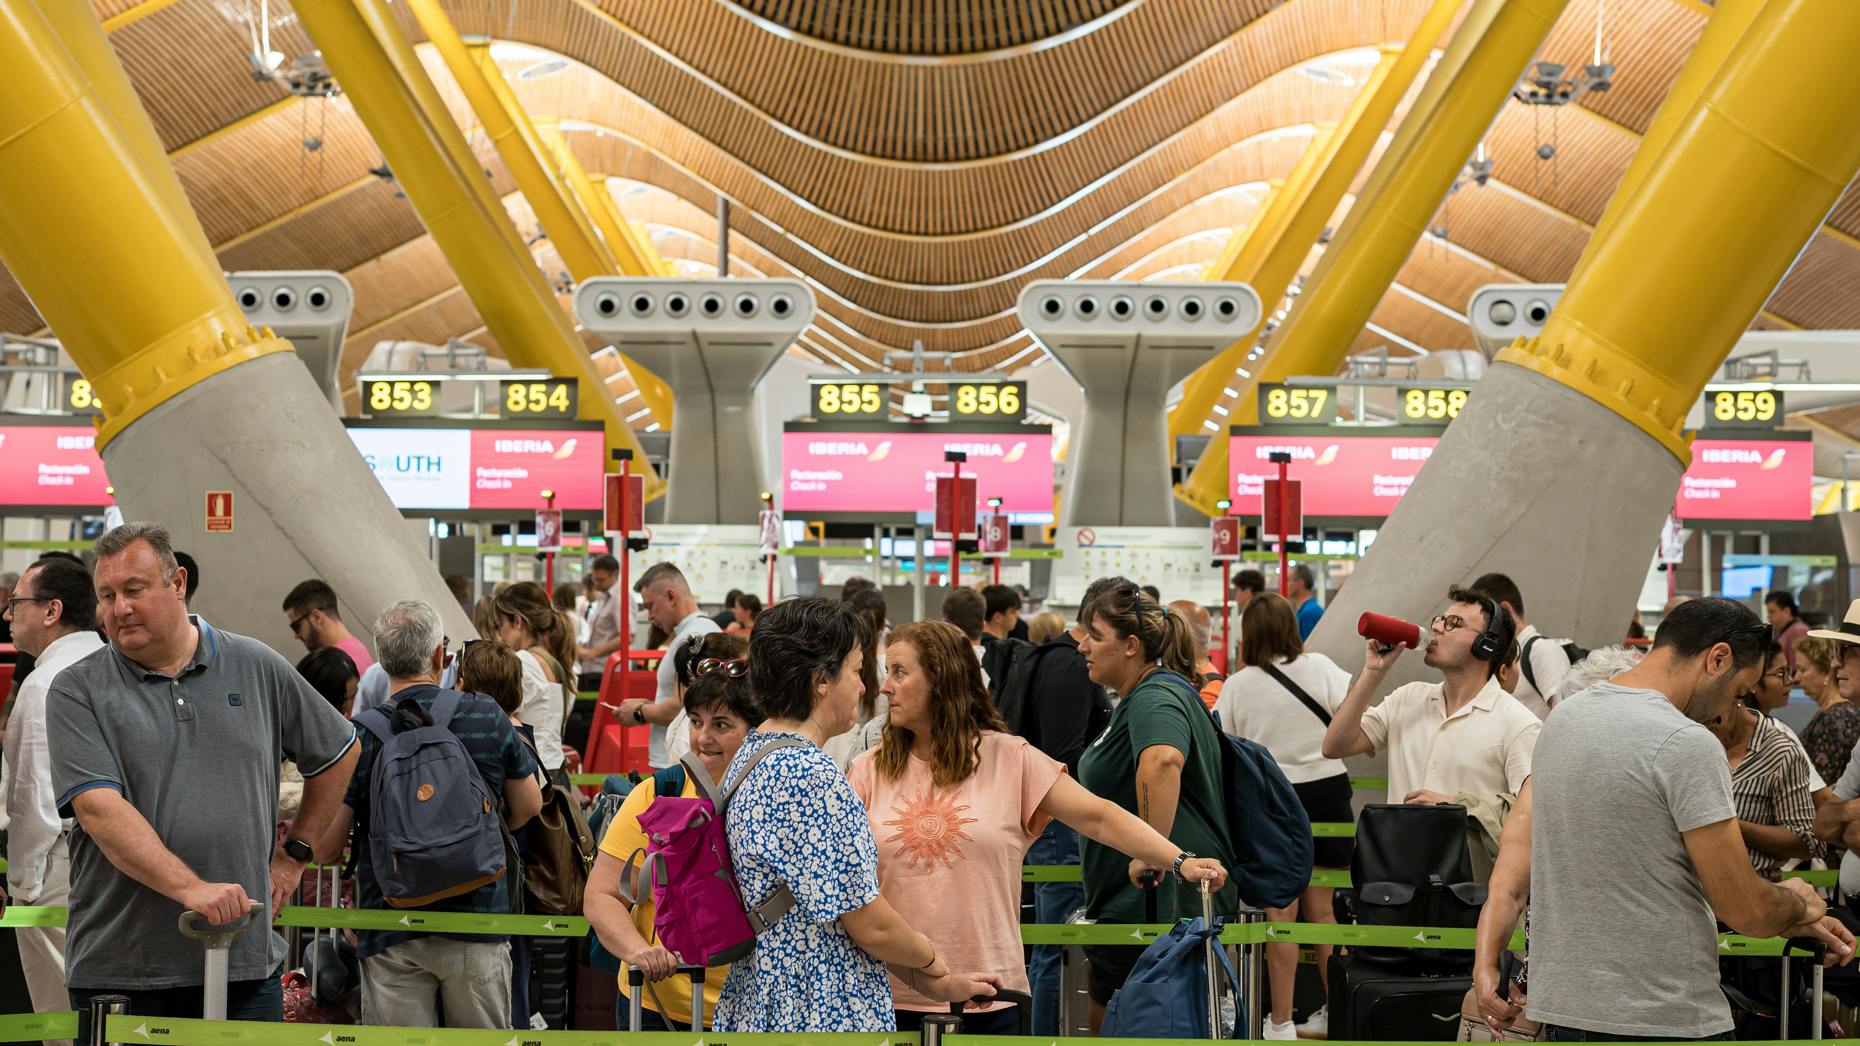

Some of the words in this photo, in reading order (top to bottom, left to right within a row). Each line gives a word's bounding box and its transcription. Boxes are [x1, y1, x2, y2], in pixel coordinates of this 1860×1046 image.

[370, 381, 432, 411] 853
[507, 383, 570, 412] 854
[819, 384, 881, 413] 855
[956, 385, 1020, 414] 856
[1267, 389, 1328, 418] 857
[1405, 390, 1467, 419] 858
[1714, 391, 1776, 421] 859
[495, 440, 554, 453] IBERIA
[808, 442, 868, 455] IBERIA
[1702, 449, 1762, 463] IBERIA
[544, 521, 554, 536] 6
[1219, 528, 1231, 544] 9
[150, 1027, 170, 1035] aena
[335, 1034, 356, 1043] aena
